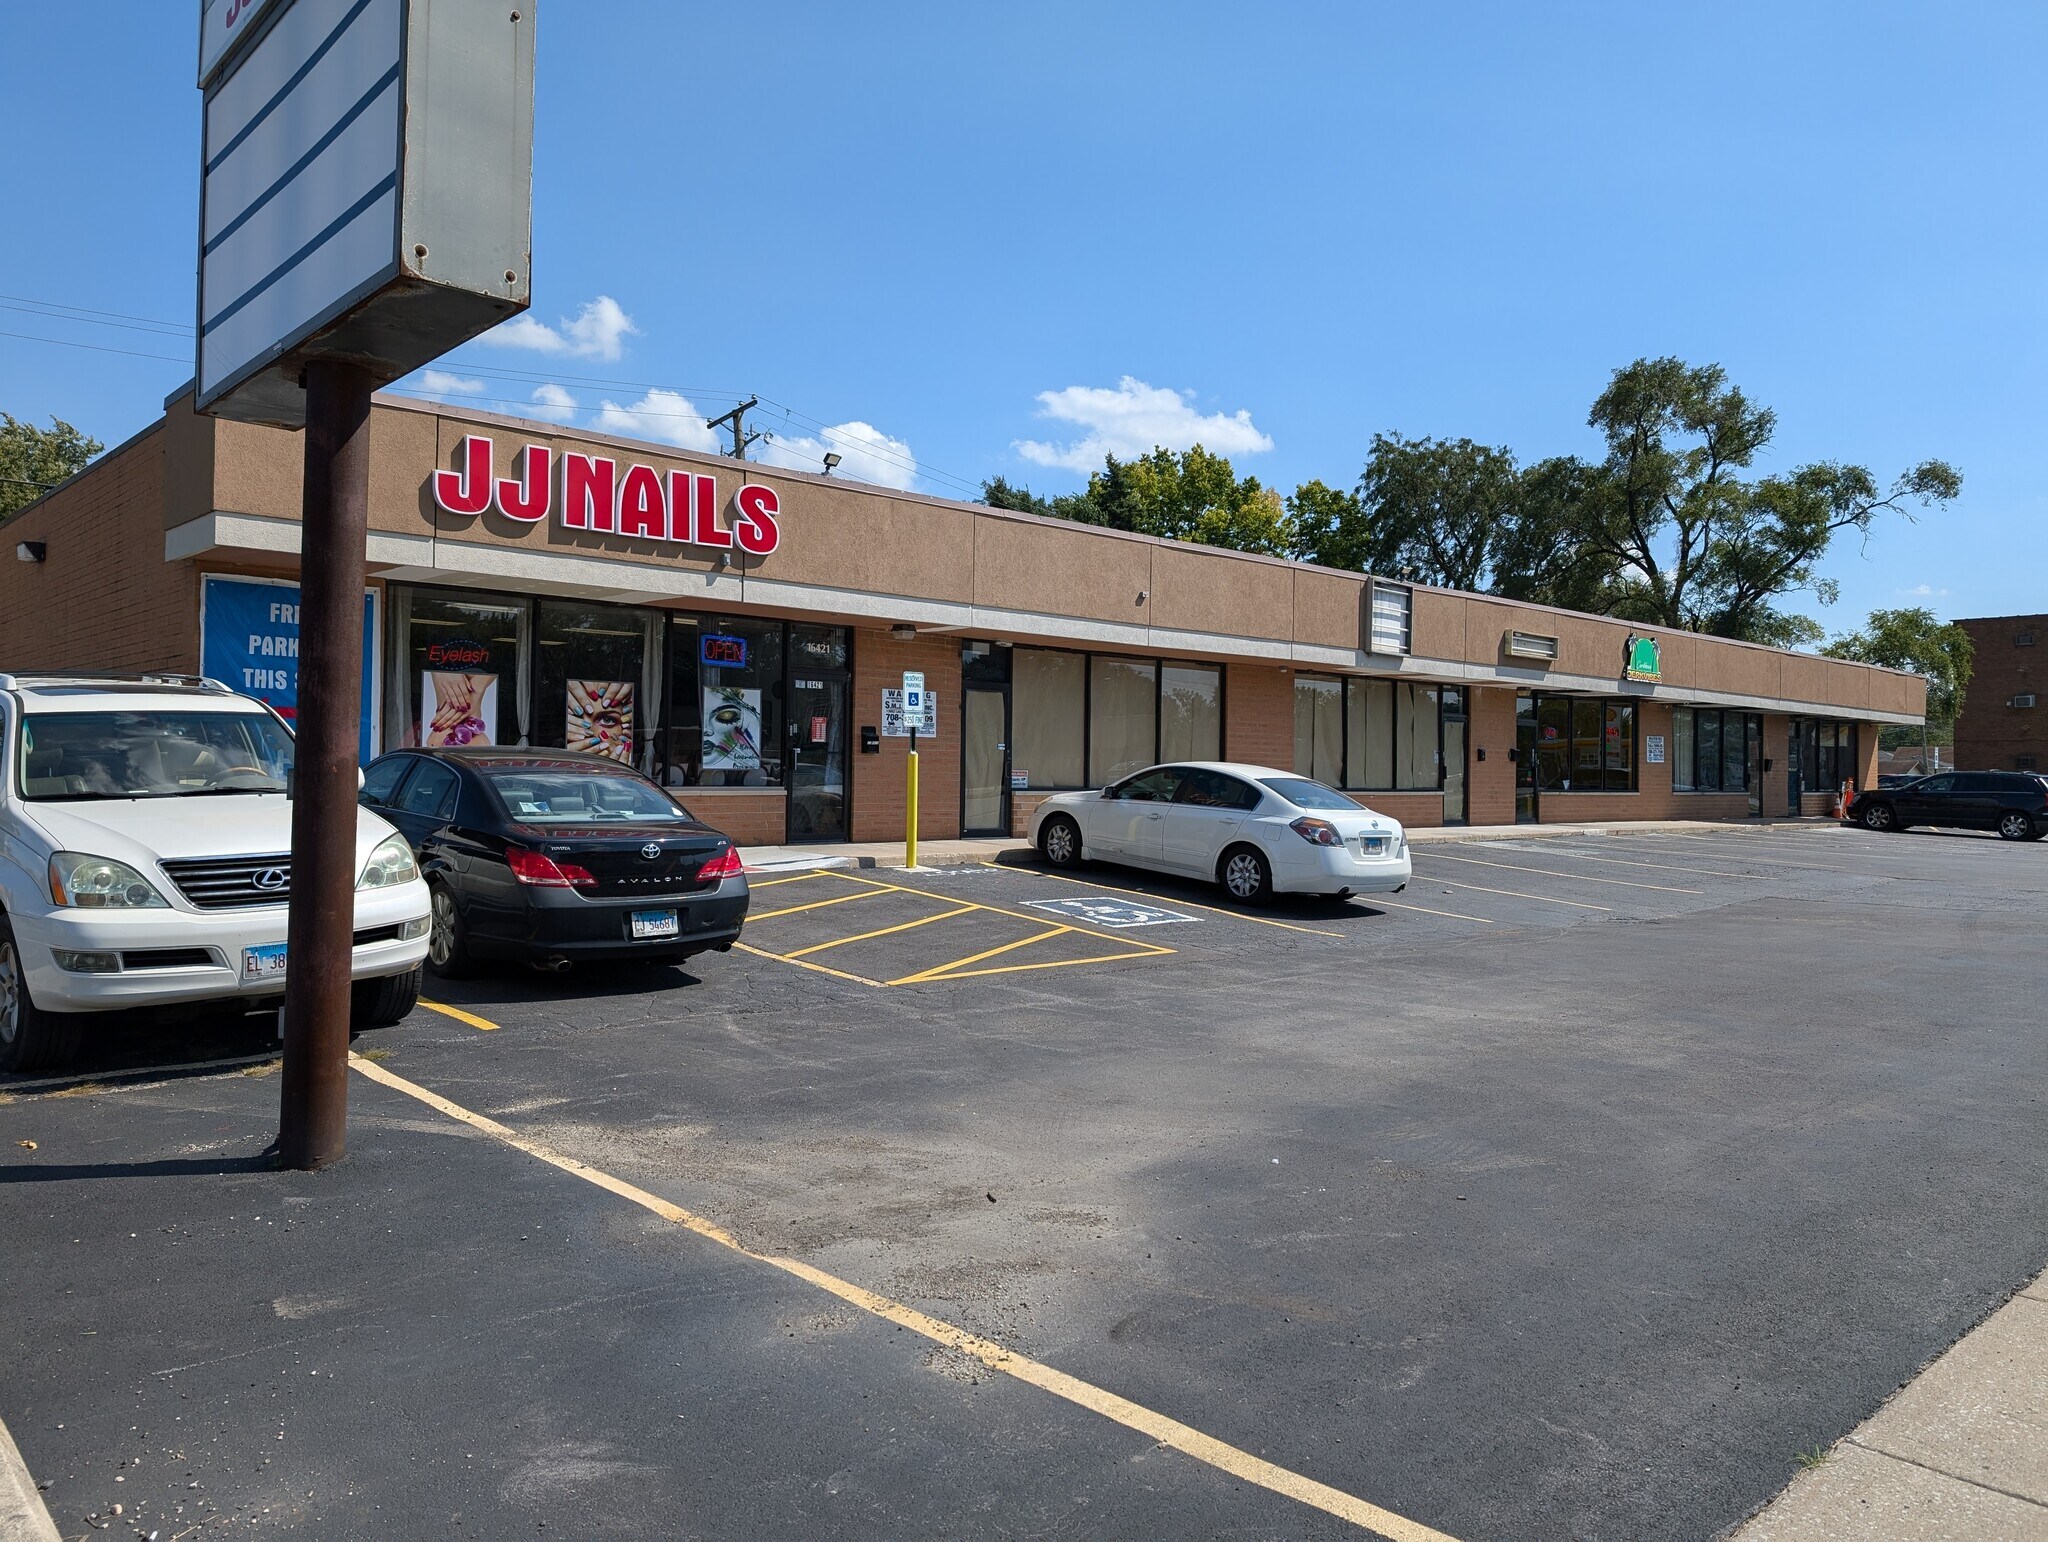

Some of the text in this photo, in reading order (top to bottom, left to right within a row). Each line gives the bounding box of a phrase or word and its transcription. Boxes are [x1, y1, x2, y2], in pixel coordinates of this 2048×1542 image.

[433, 434, 780, 555] JJ NAILS
[248, 634, 299, 658] PARK
[429, 645, 489, 664] Eyelash
[705, 640, 744, 662] OPEN
[806, 642, 830, 653] 16421
[242, 668, 287, 690] THIS
[617, 876, 683, 884] AVALON
[247, 952, 286, 972] EL 38
